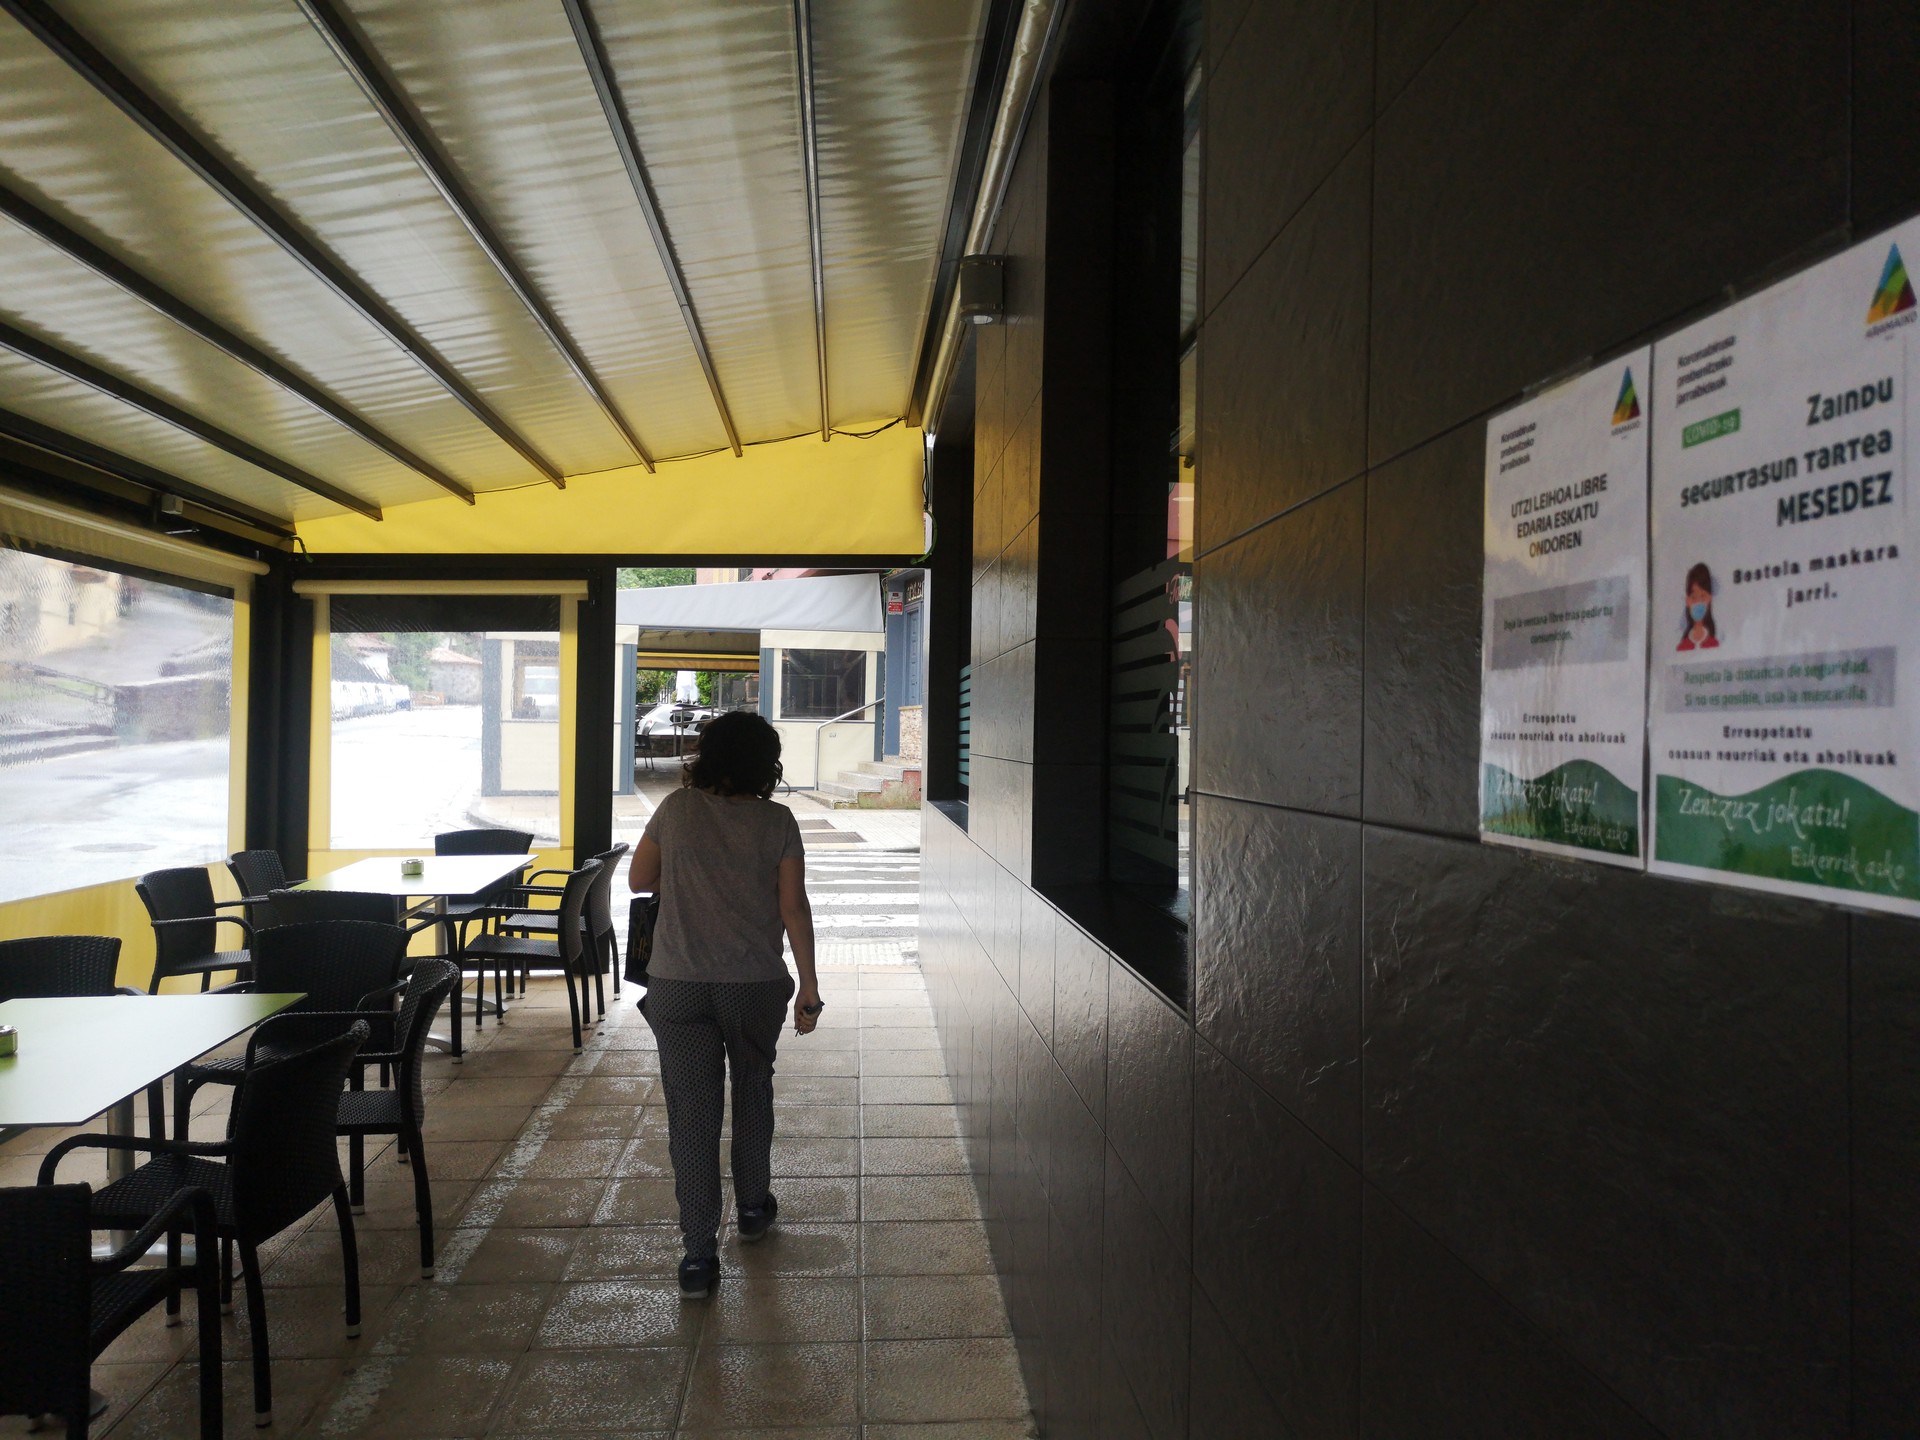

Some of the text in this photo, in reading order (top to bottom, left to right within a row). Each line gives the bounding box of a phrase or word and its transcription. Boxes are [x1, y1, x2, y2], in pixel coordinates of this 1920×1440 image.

[1511, 473, 1608, 519] UTZI LEIHOA LIBRE
[1777, 471, 1893, 527] MESEDEZ
[1517, 501, 1599, 539] EDARIA ESKATU
[1529, 530, 1582, 558] ONDOREN
[1809, 545, 1899, 571] maskara
[1786, 582, 1837, 608] jarri.
[1523, 713, 1577, 726] Errespetatu
[1723, 725, 1812, 740] Errespetatu
[1519, 731, 1554, 742] neurriak
[1558, 732, 1574, 742] eta
[1578, 732, 1626, 743] aholkuak
[1717, 749, 1776, 762] neurriak
[1783, 750, 1809, 764] eta
[1816, 749, 1897, 766] aholkuak
[1765, 786, 1849, 839] jokatu!
